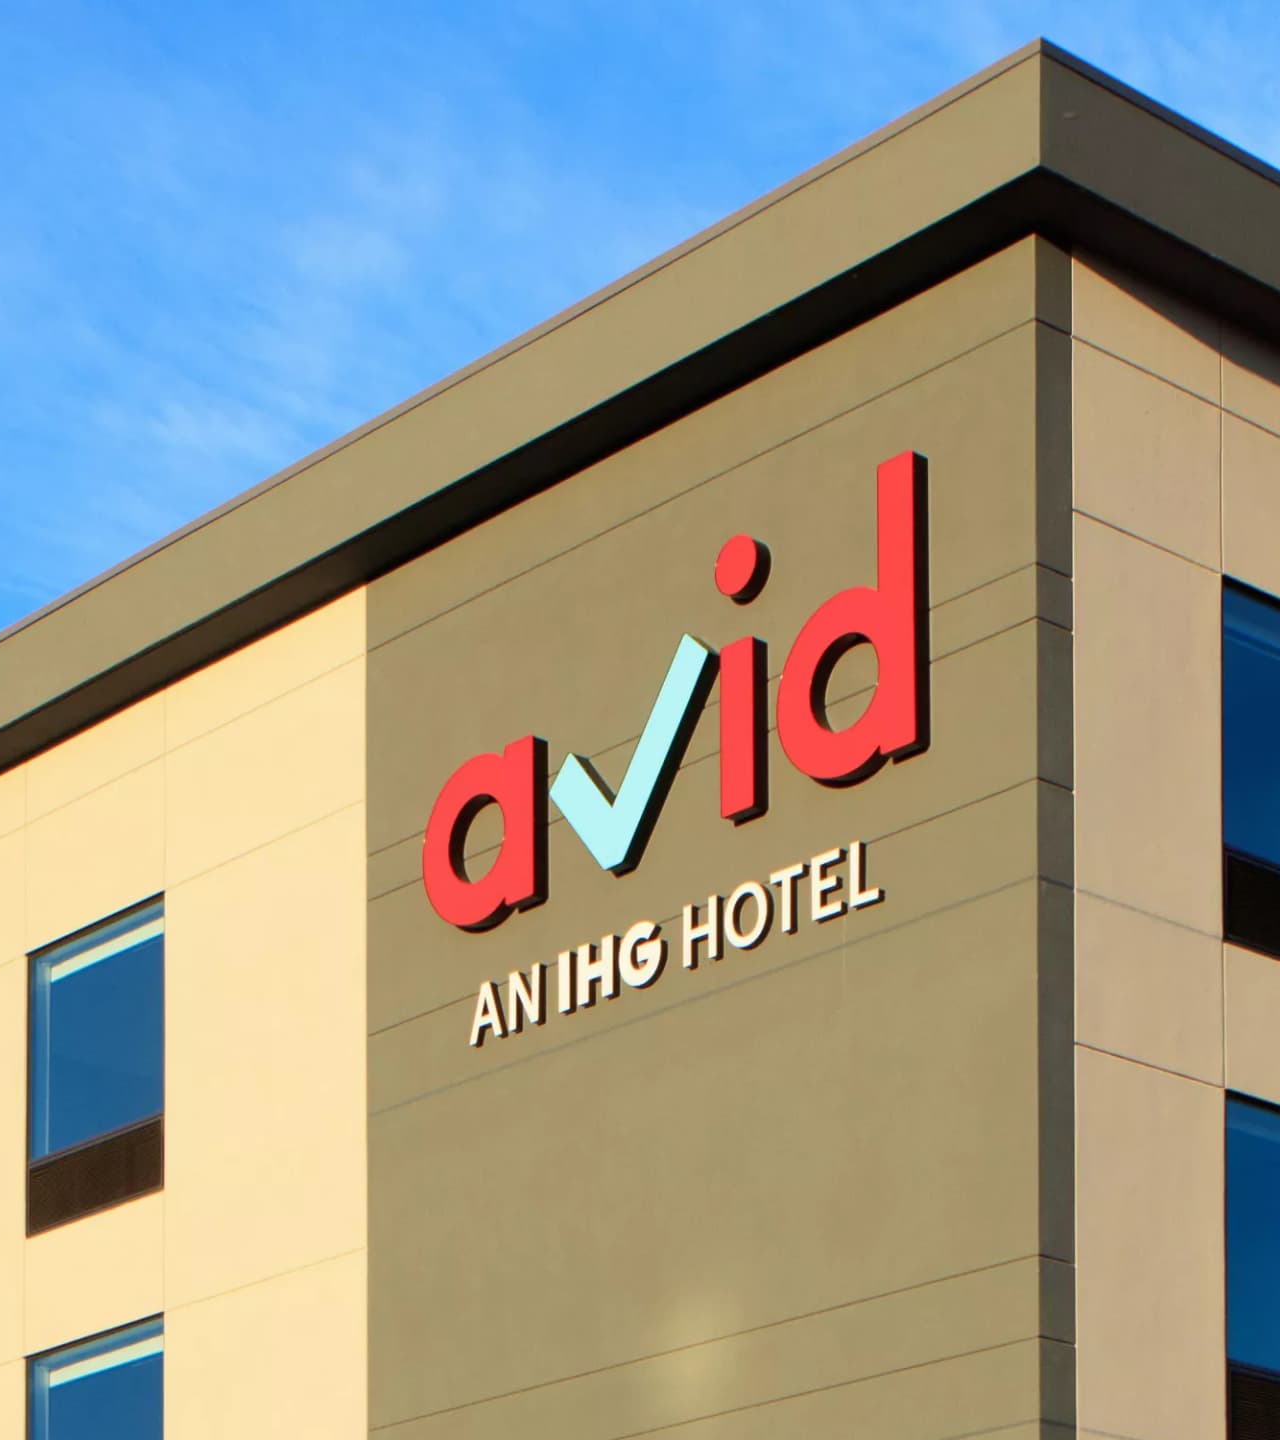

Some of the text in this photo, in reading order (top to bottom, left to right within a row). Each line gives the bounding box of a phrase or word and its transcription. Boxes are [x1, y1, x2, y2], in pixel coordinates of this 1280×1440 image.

[422, 449, 931, 933] avid
[469, 840, 885, 1047] AN IHG HOTEL
